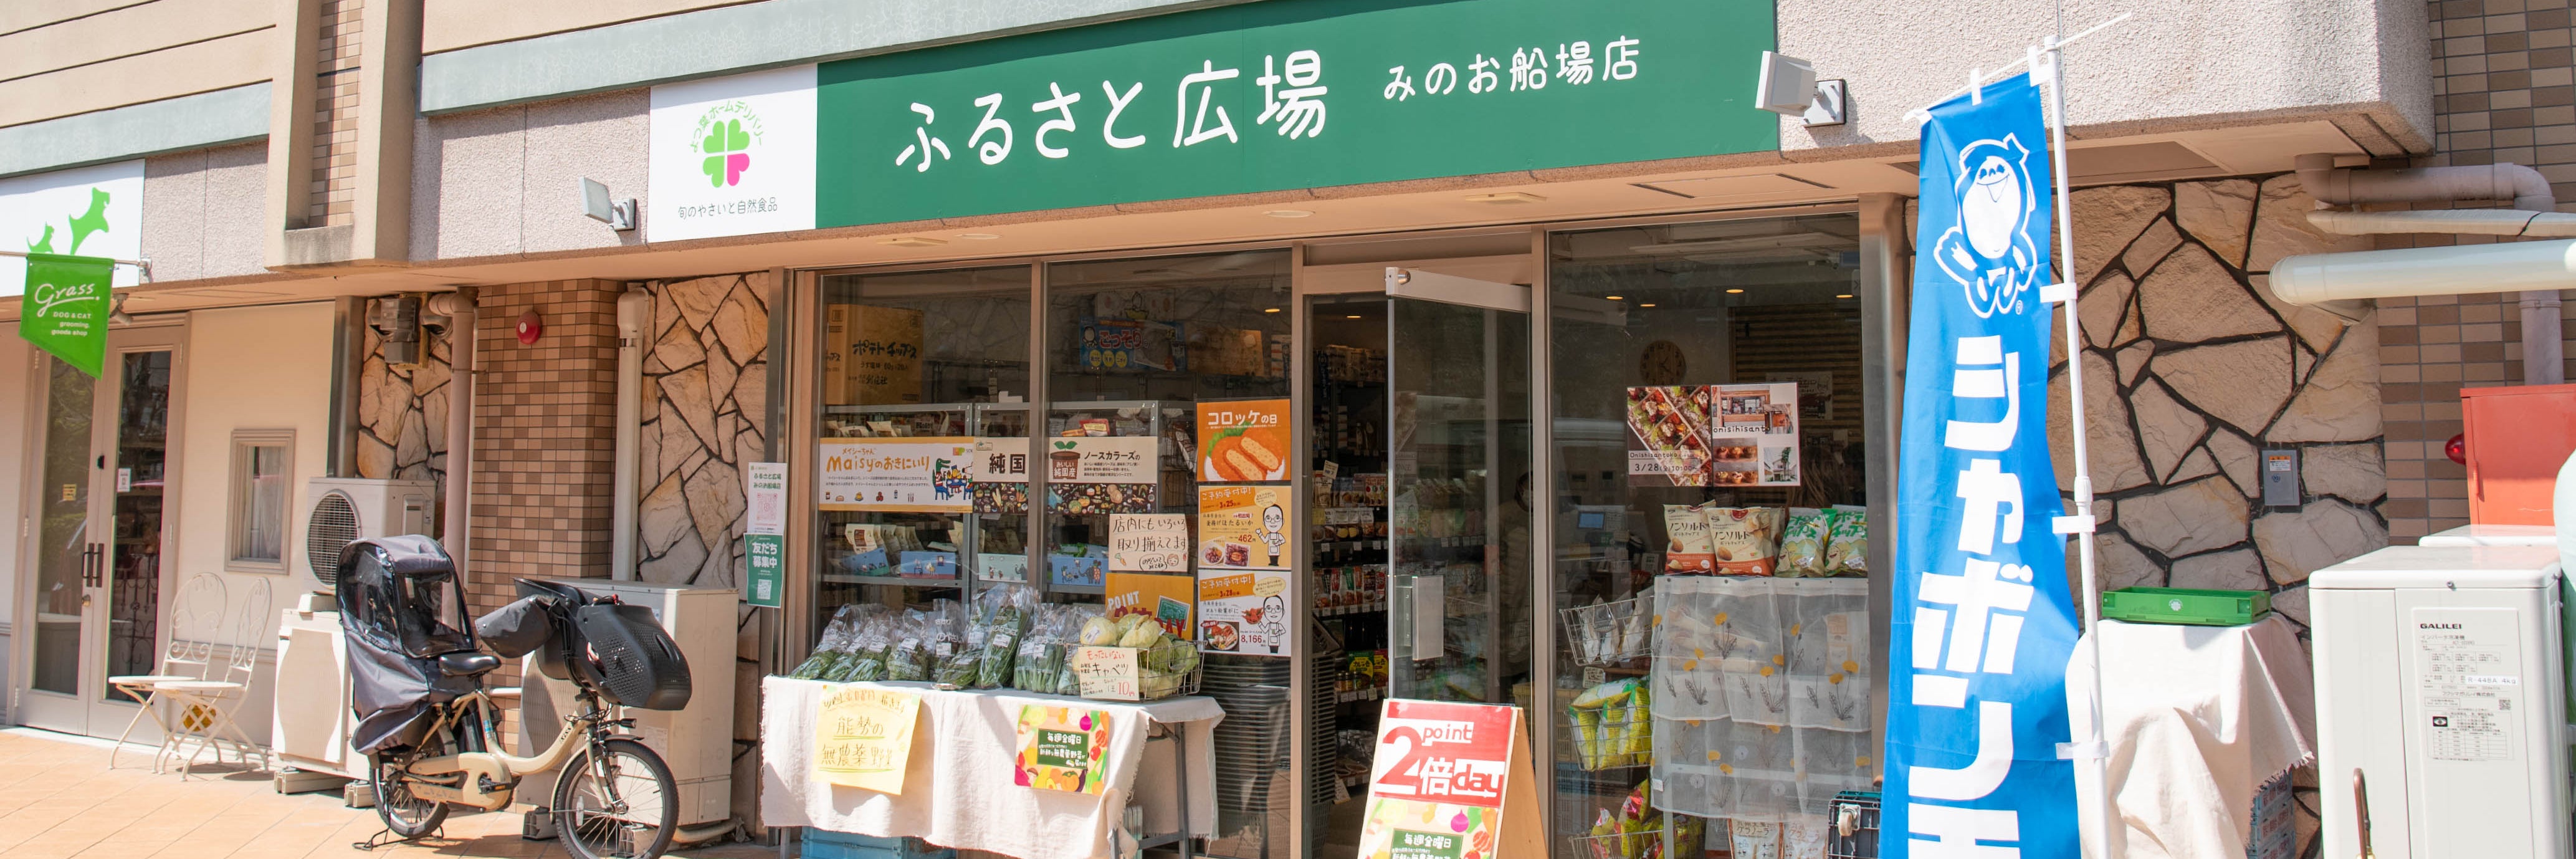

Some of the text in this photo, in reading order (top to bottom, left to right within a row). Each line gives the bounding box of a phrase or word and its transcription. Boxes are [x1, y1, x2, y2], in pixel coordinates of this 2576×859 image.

[895, 35, 1641, 173] ふるさと広場 みのお船場店
[690, 100, 764, 153] よつ葉ホームデリバリー
[678, 197, 778, 219] 旬のやさいと自然食品
[852, 339, 917, 360] ポテト チップス
[1208, 410, 1277, 425] コロッケの日
[826, 456, 929, 472] Maisyのおきにいり
[1084, 451, 1140, 461] ノースカラーズの
[1054, 468, 1076, 477] 純国産
[1113, 516, 1155, 533] 店内にも
[751, 542, 778, 555] 友だち
[1118, 535, 1186, 552] 取り揃えてます
[753, 555, 778, 569] 募集中
[1107, 591, 1139, 610] POINT
[1087, 650, 1126, 660] もったいない
[1092, 663, 1128, 677] キャベツ
[1047, 732, 1082, 745] 毎週金曜日
[1423, 724, 1472, 744] point
[1404, 832, 1452, 850] 毎週金曜日
